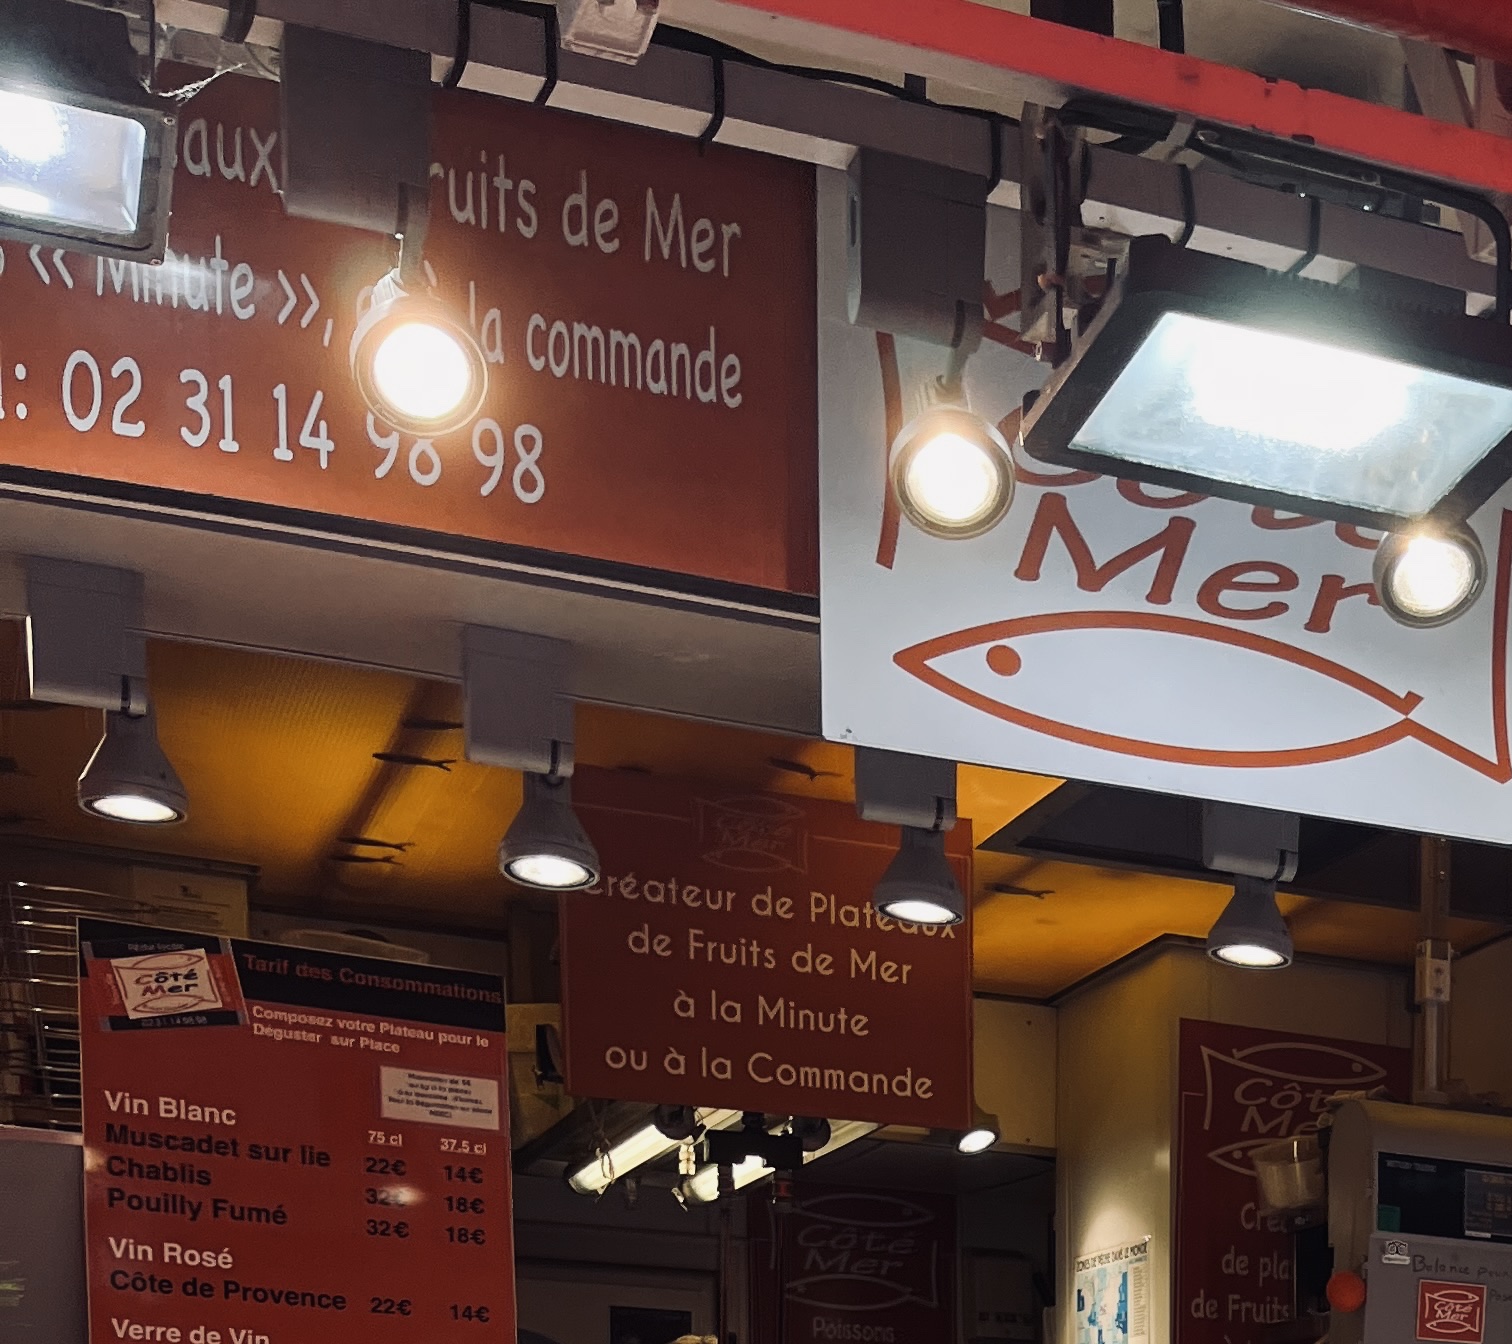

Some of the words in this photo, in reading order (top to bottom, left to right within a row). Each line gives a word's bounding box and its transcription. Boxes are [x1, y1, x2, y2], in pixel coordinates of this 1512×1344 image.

[563, 169, 621, 254] de
[644, 188, 740, 276] Mer
[468, 282, 503, 364] la
[526, 312, 742, 408] commande
[61, 350, 145, 437] 02
[179, 369, 239, 453] 31
[274, 383, 334, 469] 14
[471, 417, 546, 503] 98
[1014, 492, 1388, 632] Mer
[751, 886, 794, 919] de
[243, 954, 289, 976] Tarif
[628, 924, 672, 957] de
[688, 929, 776, 969] Fruits
[792, 944, 834, 976] de
[850, 948, 912, 984] Mer
[379, 1022, 434, 1041] Plateau
[674, 989, 695, 1018] à
[711, 990, 741, 1023] la
[758, 995, 870, 1036] Minute
[360, 1037, 400, 1053] Place
[605, 1046, 647, 1071] ou
[664, 1047, 686, 1076] à
[701, 1047, 732, 1079] la
[748, 1052, 933, 1099] Commande
[104, 1090, 149, 1116] Vin
[158, 1096, 236, 1126] Blanc
[105, 1123, 240, 1158] Muscadet
[248, 1143, 291, 1163] sur
[300, 1145, 331, 1167] lie
[366, 1157, 406, 1177] 22€
[443, 1165, 484, 1184] 14€
[107, 1155, 212, 1186] Chablis
[107, 1187, 203, 1221] Pouilly
[212, 1198, 288, 1225] Fumé
[108, 1237, 153, 1262] Vin
[163, 1242, 234, 1269] Rosé
[109, 1269, 174, 1296] Côte
[182, 1276, 215, 1298] de
[223, 1281, 348, 1311] Provence
[111, 1317, 182, 1343] Verre
